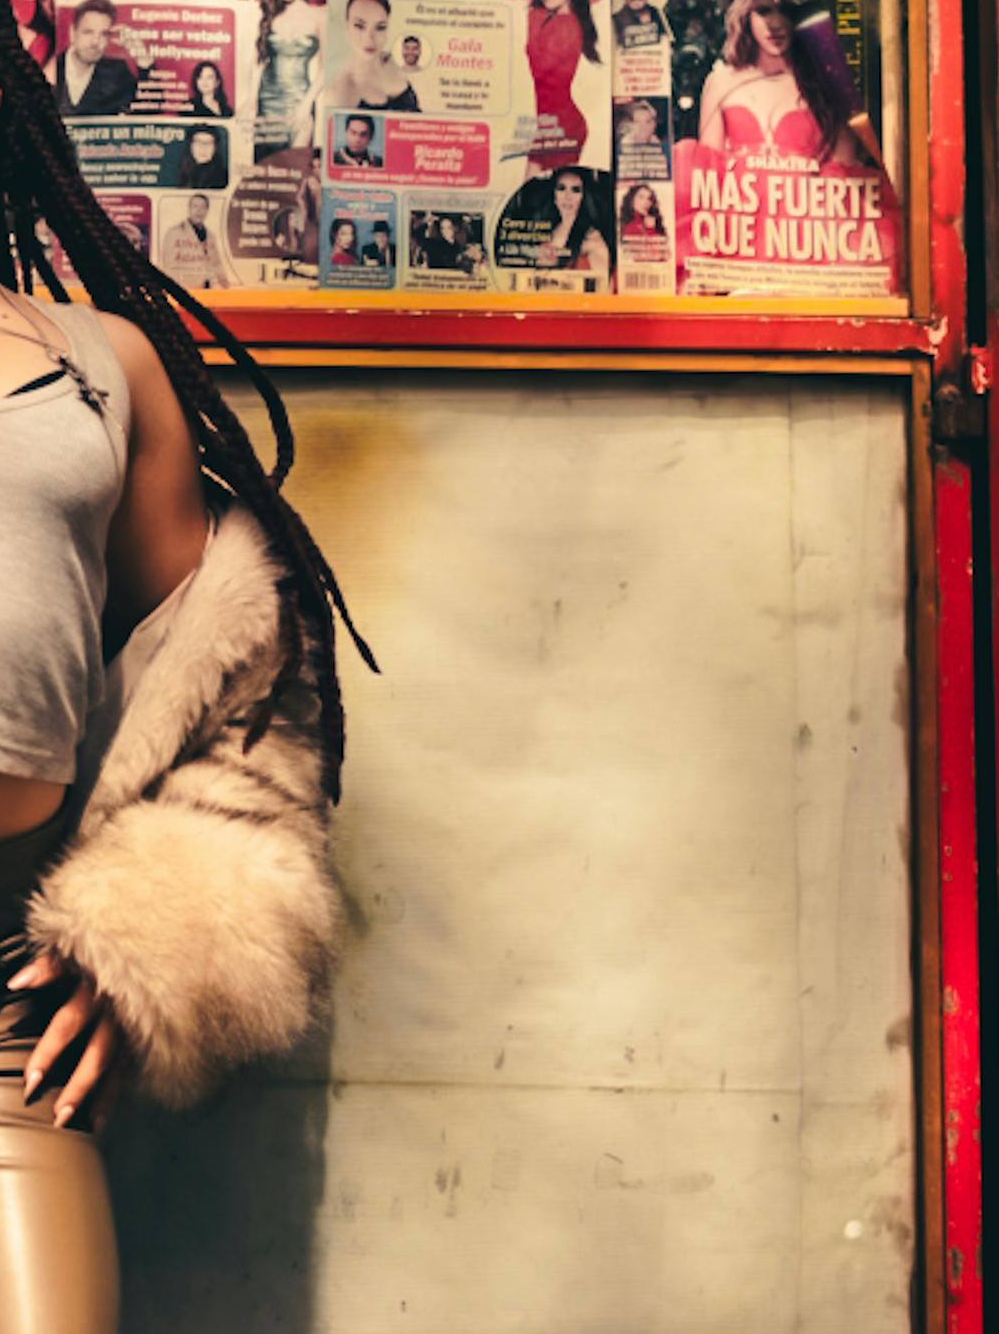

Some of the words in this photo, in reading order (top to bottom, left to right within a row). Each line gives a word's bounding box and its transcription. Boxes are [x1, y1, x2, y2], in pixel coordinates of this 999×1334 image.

[436, 54, 495, 71] Montes
[745, 155, 821, 172] SHAKIRA
[690, 162, 758, 214] MÁS
[766, 174, 883, 220] FUERTE
[691, 211, 756, 258] QUE
[765, 218, 884, 262] NUNCA
